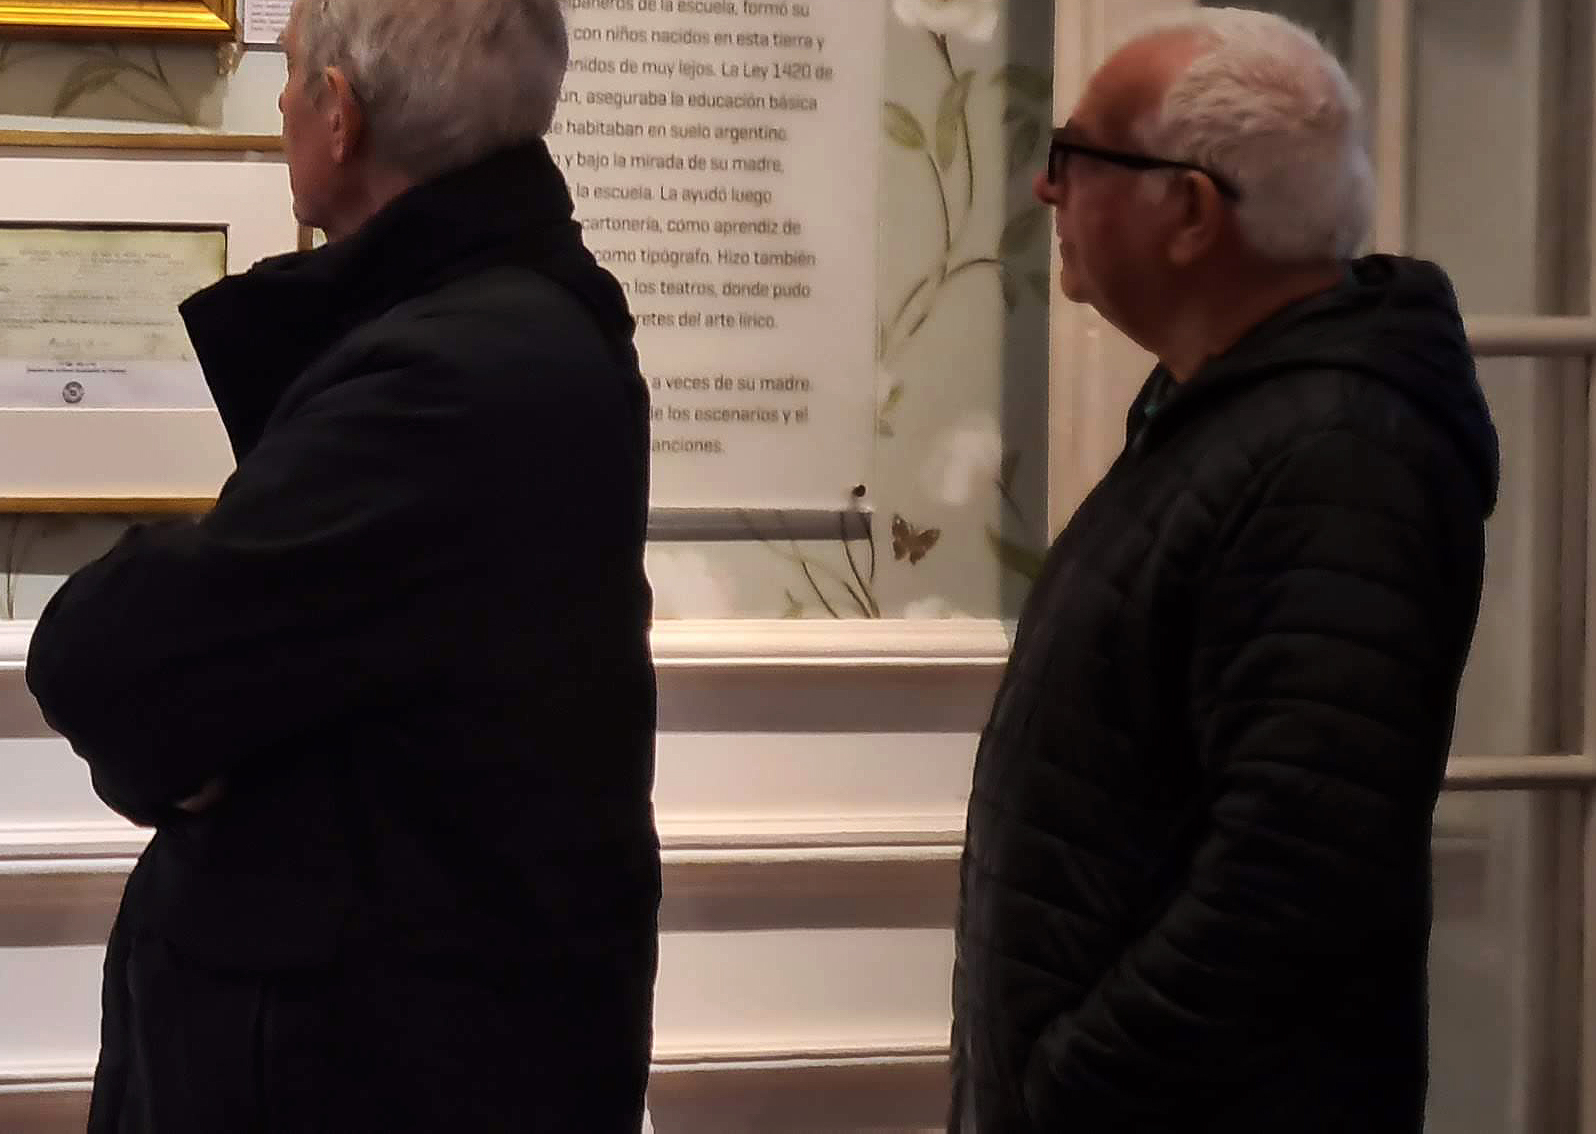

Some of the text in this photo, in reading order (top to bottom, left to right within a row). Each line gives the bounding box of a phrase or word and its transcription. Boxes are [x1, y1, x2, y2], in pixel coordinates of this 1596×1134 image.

[792, 4, 809, 17] su
[574, 27, 601, 41] con
[606, 27, 647, 43] niños
[714, 33, 732, 46] en
[736, 32, 769, 48] esta
[619, 58, 638, 74] de
[642, 62, 674, 79] muy
[721, 62, 738, 78] La
[815, 66, 832, 82] de
[586, 87, 666, 109] aseguraba
[567, 118, 710, 139] habitaban en suelo
[577, 150, 609, 170] bajo
[630, 152, 683, 169] mirada
[687, 154, 706, 170] de
[710, 157, 728, 171] su
[660, 185, 678, 201] La
[731, 188, 771, 208] luego
[667, 219, 800, 235] como de
[717, 248, 749, 264] Hizo
[634, 277, 810, 301] los donde pudo
[678, 310, 734, 327] del arte
[665, 375, 709, 389] veces
[714, 374, 732, 390] de
[737, 377, 755, 390] su
[667, 404, 690, 420] los
